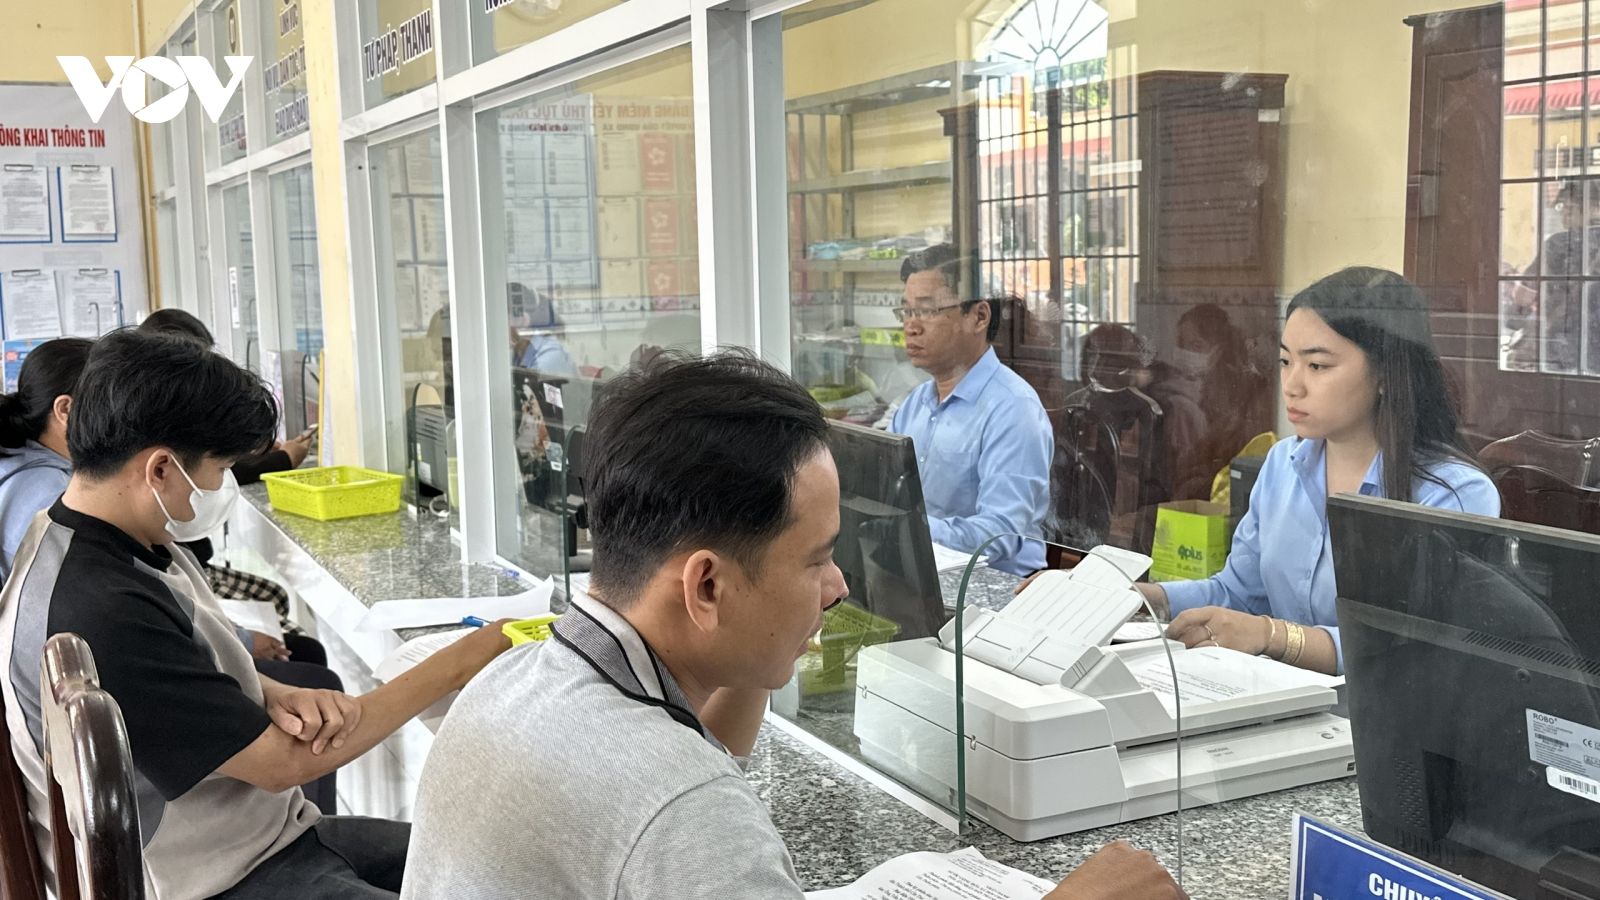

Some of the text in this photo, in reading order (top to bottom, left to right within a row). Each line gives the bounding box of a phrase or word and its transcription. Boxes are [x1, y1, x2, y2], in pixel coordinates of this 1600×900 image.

[364, 8, 433, 81] TƯ PHÁP, THANH
[23, 128, 49, 147] KHAI
[51, 124, 86, 147] THÔNG
[88, 129, 105, 147] TIN
